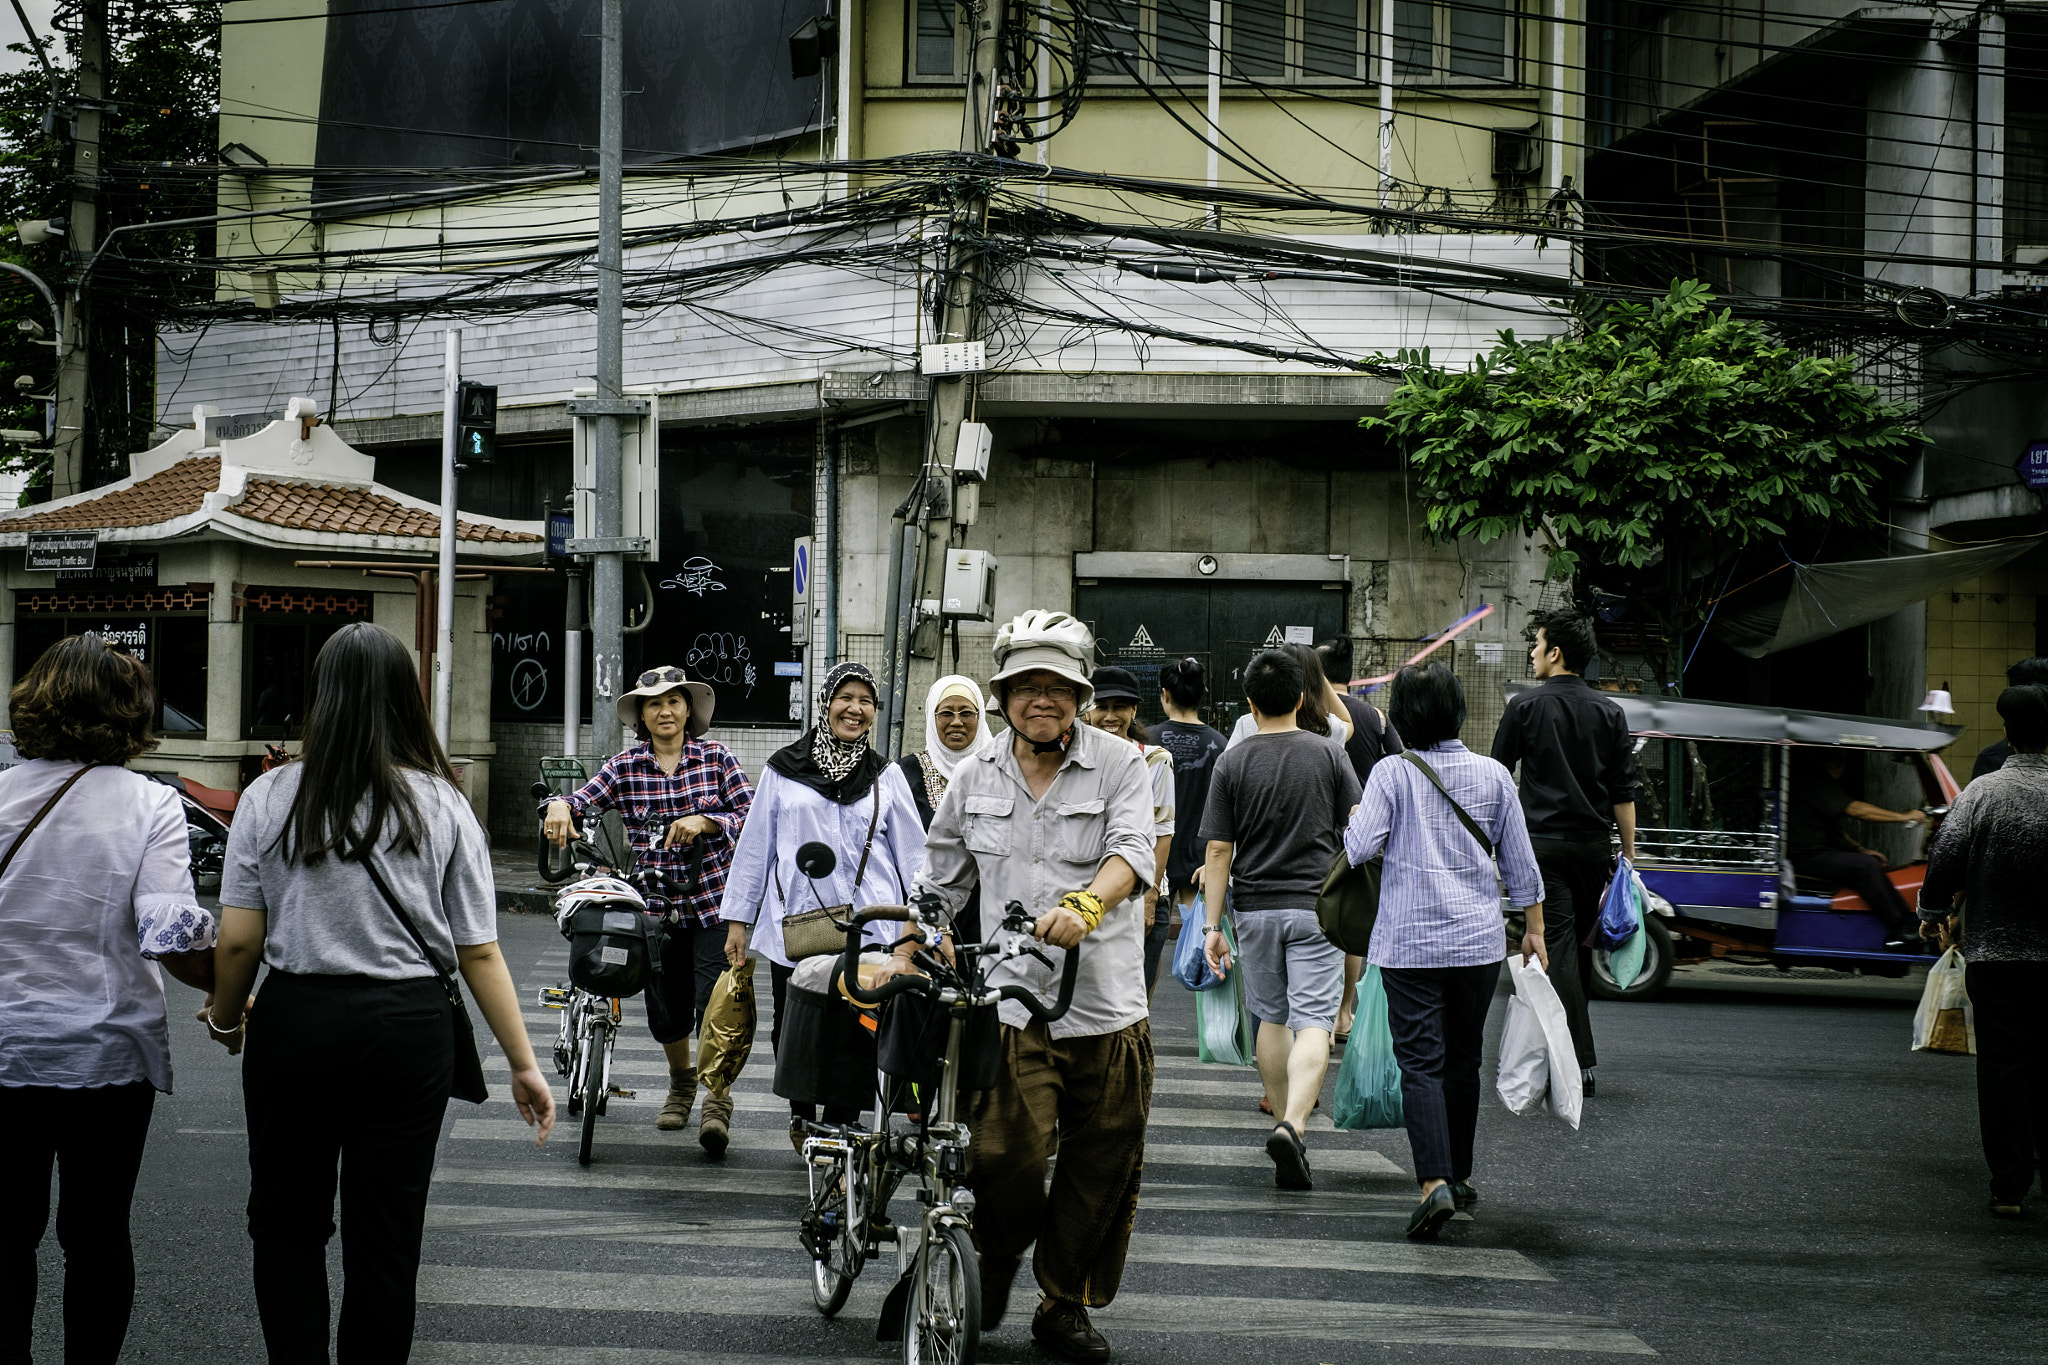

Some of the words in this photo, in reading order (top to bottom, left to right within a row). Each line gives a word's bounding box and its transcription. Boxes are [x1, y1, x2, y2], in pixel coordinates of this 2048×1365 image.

[32, 556, 61, 568] Ratchawong
[62, 555, 77, 566] Traffic
[77, 555, 87, 565] Box
